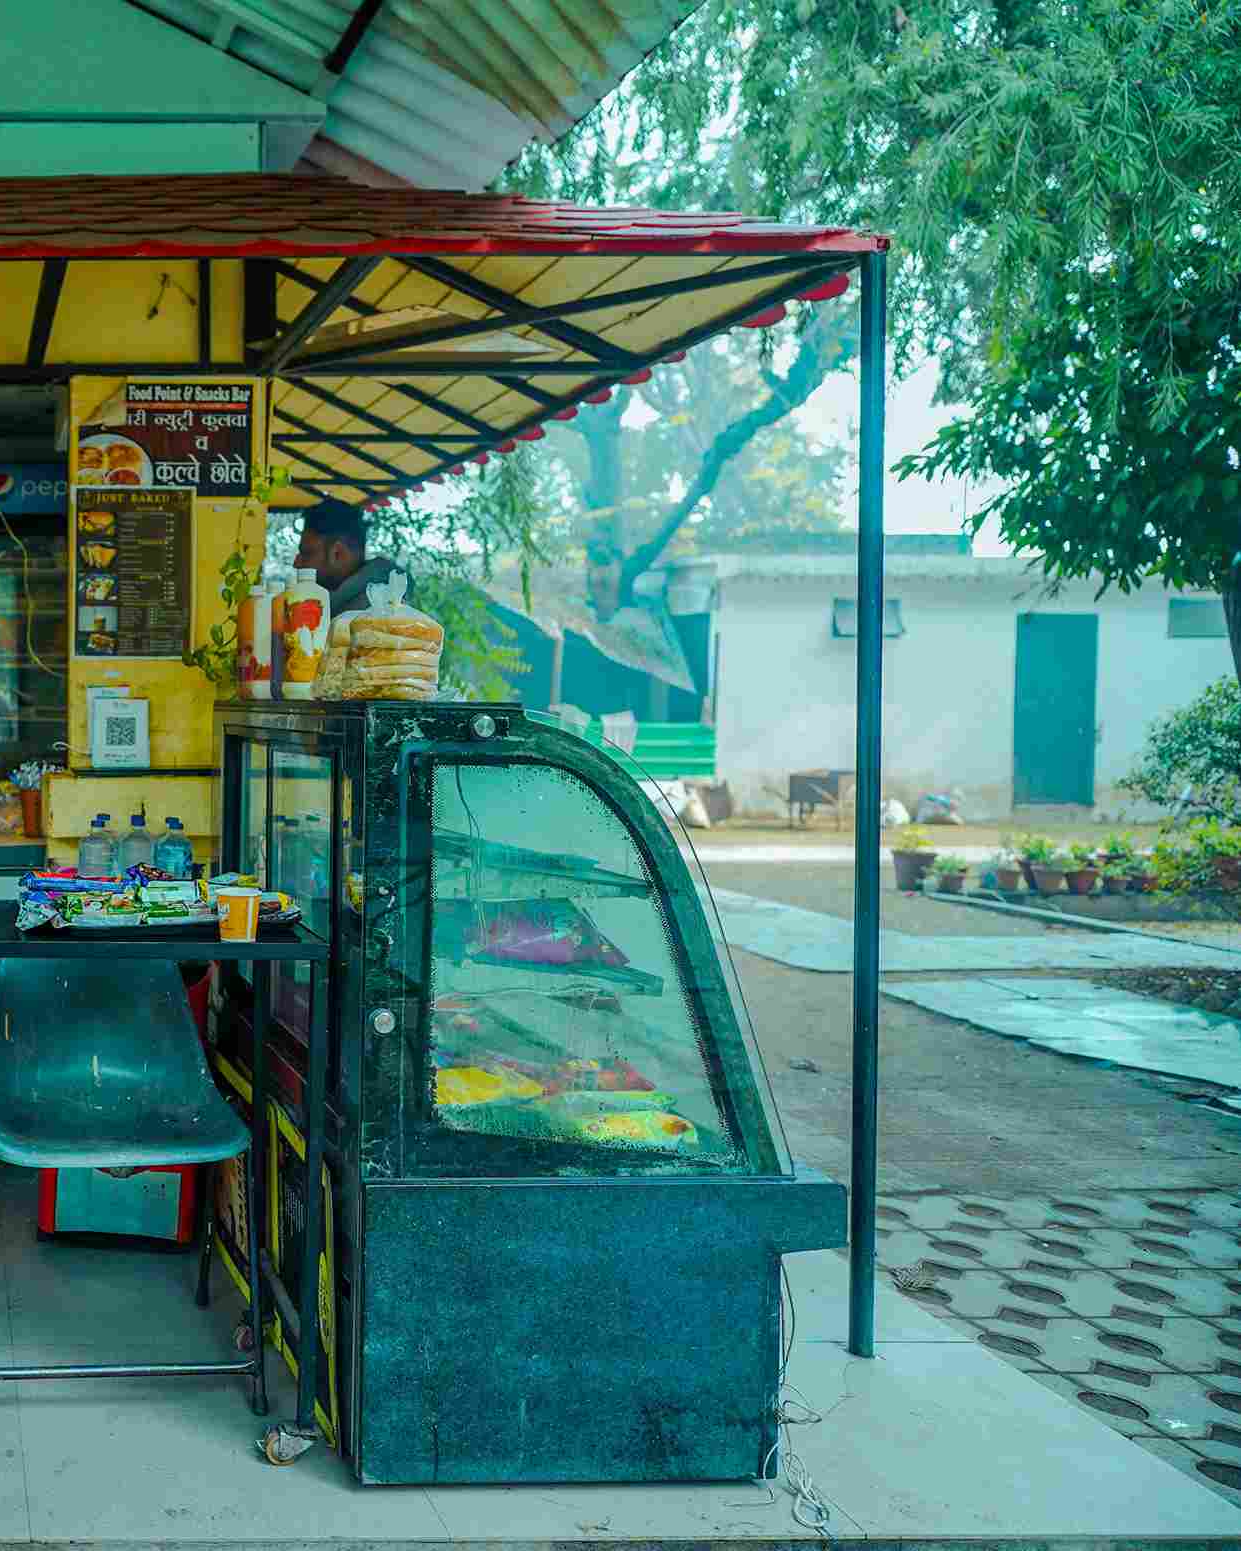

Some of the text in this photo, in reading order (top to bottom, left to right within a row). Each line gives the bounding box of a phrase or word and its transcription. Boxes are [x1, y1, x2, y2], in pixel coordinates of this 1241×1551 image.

[128, 385, 250, 402] Food Point & Snacks Bar
